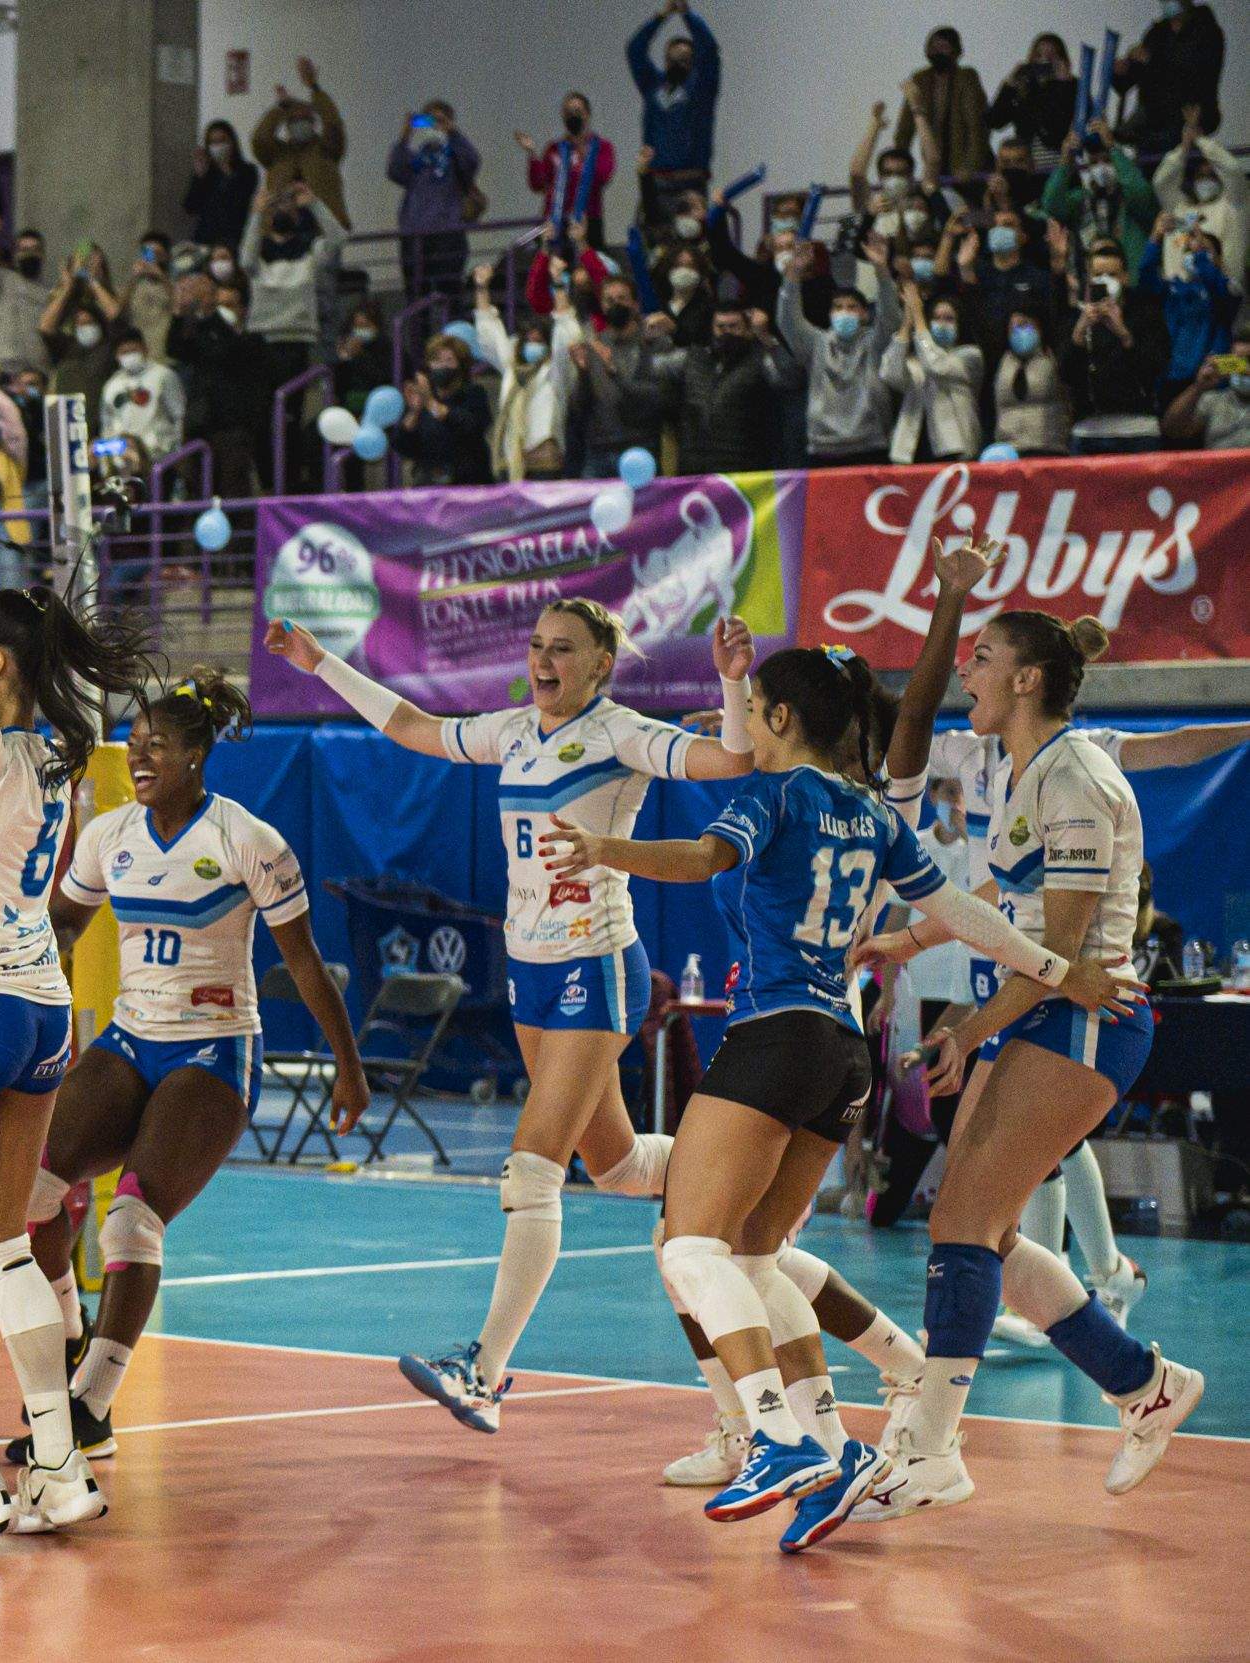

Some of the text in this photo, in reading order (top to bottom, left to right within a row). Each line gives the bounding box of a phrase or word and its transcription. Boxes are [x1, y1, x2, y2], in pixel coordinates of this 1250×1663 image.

[516, 818, 533, 859] 6
[791, 846, 876, 949] 13
[143, 928, 182, 966] 10
